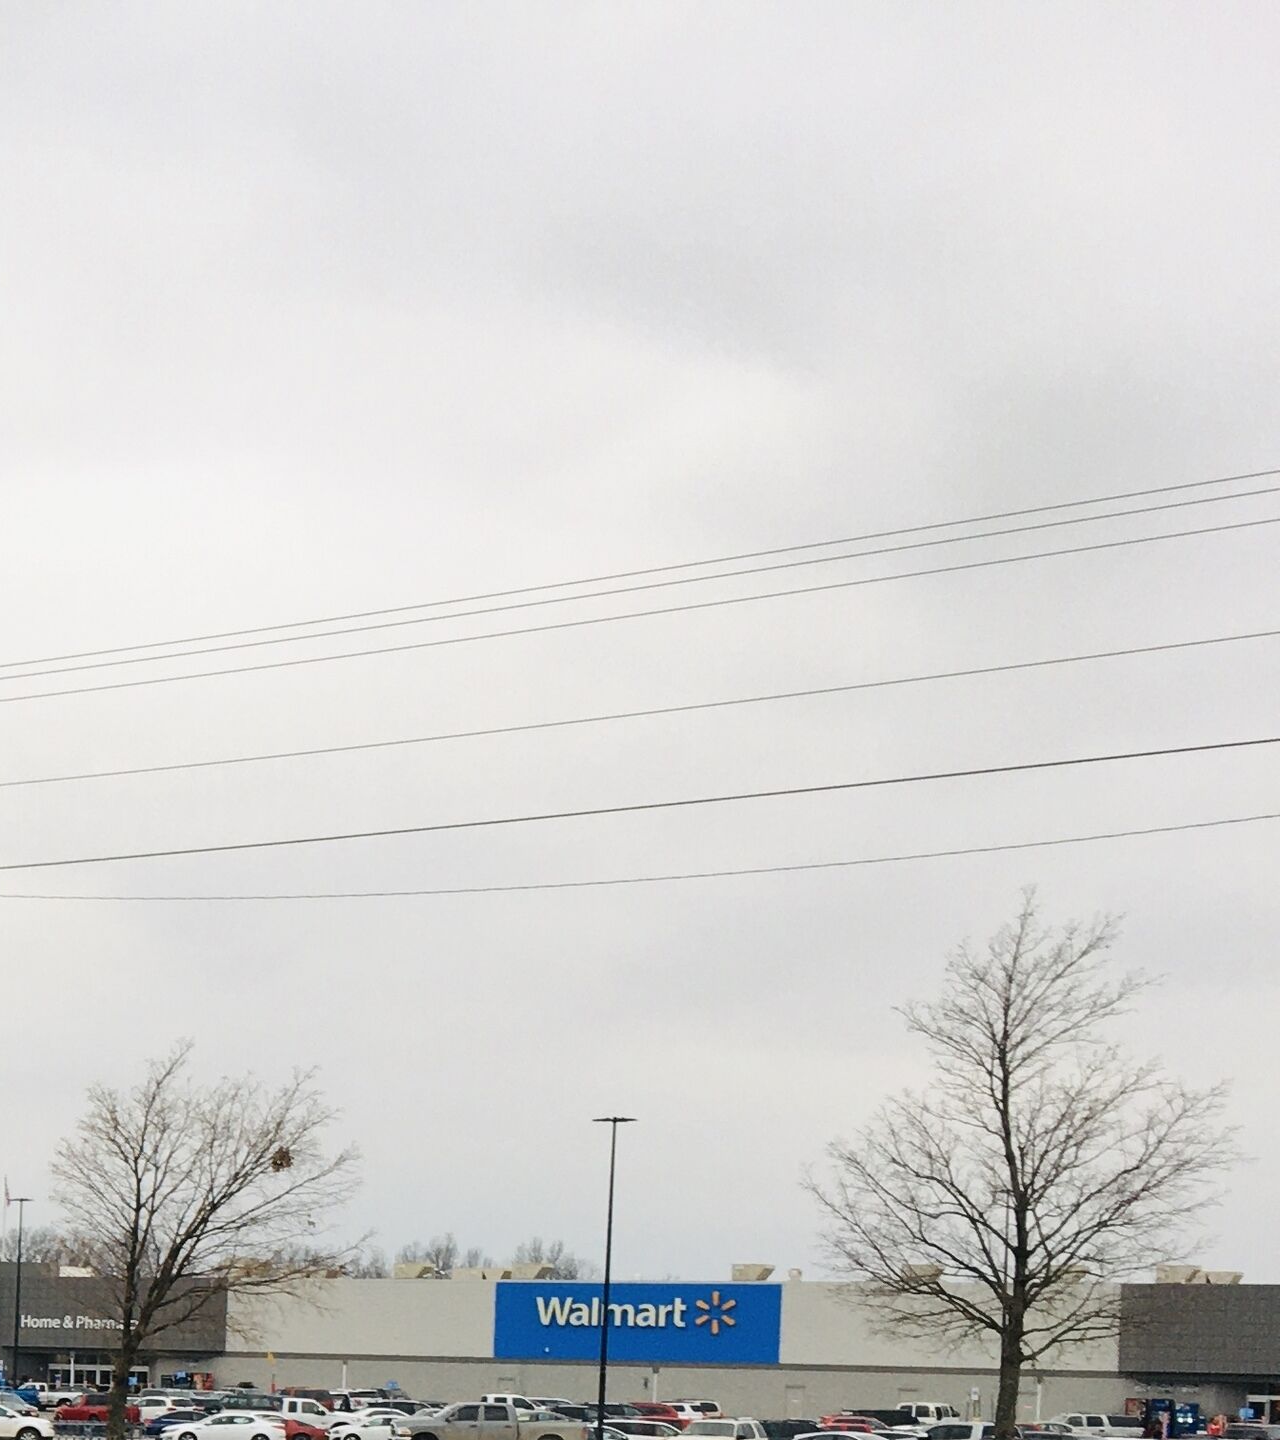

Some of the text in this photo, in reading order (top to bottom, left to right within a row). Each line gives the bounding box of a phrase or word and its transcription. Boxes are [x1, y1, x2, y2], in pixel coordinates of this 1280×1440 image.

[20, 1314, 61, 1329] Home
[62, 1314, 74, 1329] &
[536, 1297, 687, 1328] Walmart
